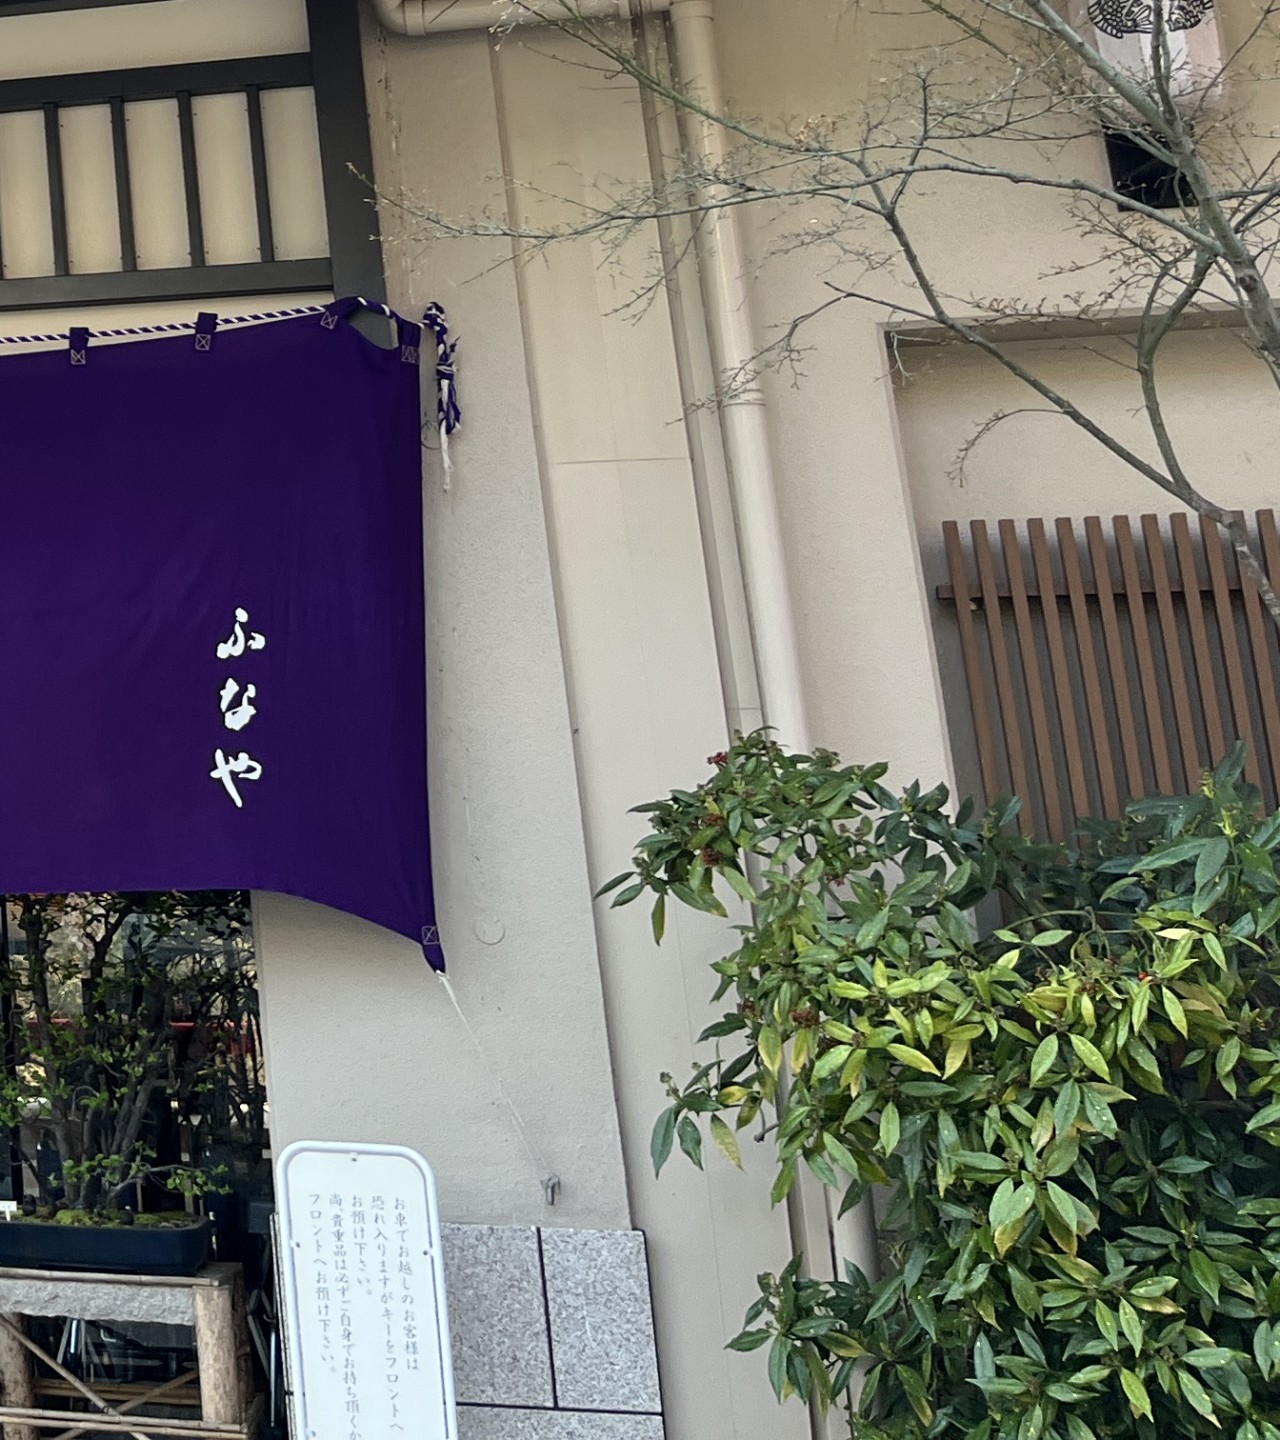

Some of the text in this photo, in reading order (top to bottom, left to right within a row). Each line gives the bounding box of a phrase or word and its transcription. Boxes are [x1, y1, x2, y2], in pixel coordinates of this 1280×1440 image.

[209, 607, 266, 808] ふなや
[309, 1193, 336, 1372] フロントへお預け下さい。
[352, 1195, 373, 1295] お預け下さい。
[371, 1196, 403, 1431] 恐れ入りますがキーをフロントへ
[394, 1198, 419, 1370] お車でお越しのお客様は
